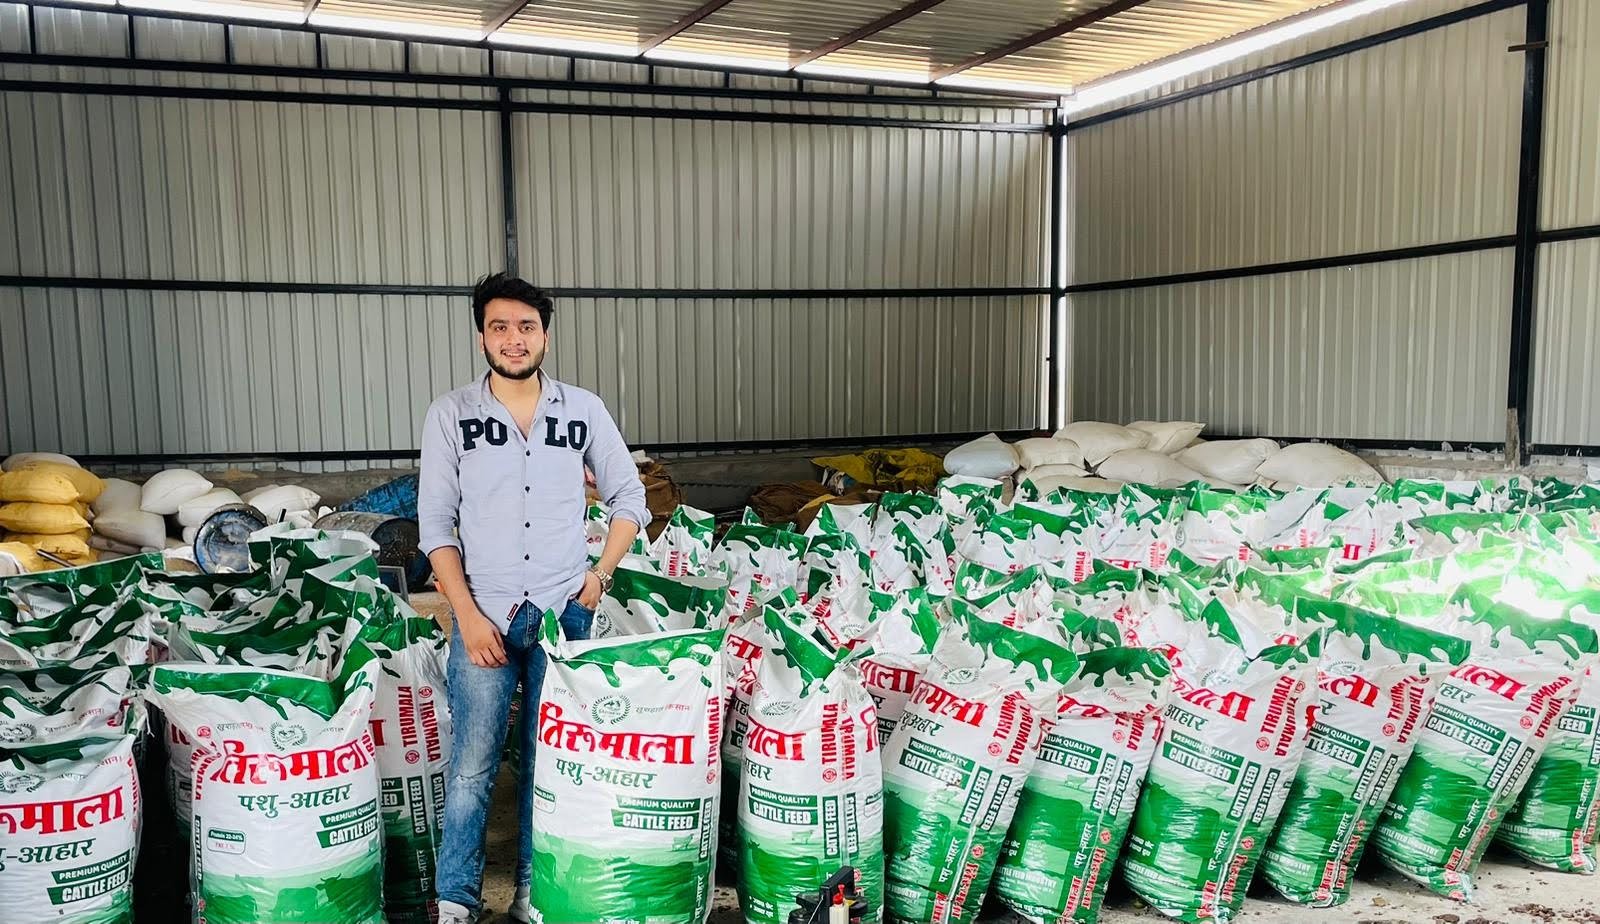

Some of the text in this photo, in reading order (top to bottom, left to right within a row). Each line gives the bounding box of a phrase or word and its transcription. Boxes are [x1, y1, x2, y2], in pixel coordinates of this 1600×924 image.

[1074, 551, 1086, 582] RUMALA
[398, 686, 418, 748] TIRUMALA
[1260, 676, 1296, 734] TIRUMALA
[1397, 685, 1425, 744] TIRUMALA
[1435, 703, 1500, 736] PREMIUM QUALITY
[419, 699, 442, 763] TIRUMALA
[538, 701, 695, 765] तिरूमाला
[706, 696, 720, 766] TIRUMALA
[821, 703, 839, 765] TIRUMALA
[1274, 697, 1299, 757] TIRUMALA
[1332, 727, 1364, 747] QUALITY
[1427, 716, 1494, 754] CATTLE FEED
[1561, 719, 1587, 733] FEED
[935, 747, 968, 766] QUALITY
[1062, 739, 1096, 754] QUALITY
[1064, 754, 1091, 772] FEED
[1169, 745, 1232, 782] CATTLE FEED
[1173, 732, 1237, 763] PREMIUM QUALITY
[1331, 747, 1358, 766] FEED
[556, 758, 658, 789] पशु-आहार
[905, 754, 936, 778] CATTLE
[1114, 764, 1132, 797] CATTLE
[1353, 749, 1384, 801] CATTLE FEED
[1376, 756, 1397, 788] CATTLE
[1486, 740, 1518, 790] CATTLE FEED
[1511, 750, 1533, 781] CATTLE
[238, 783, 353, 819] पशु-आहार
[410, 779, 427, 835] CATTLE FEED
[432, 775, 446, 809] CATTLE
[620, 797, 695, 809] PREMIUM QUALITY
[750, 786, 810, 805] PREMIUM QUALITY
[960, 770, 990, 824] CATTLE FEED
[980, 778, 1009, 831] CATTLE FEED
[1230, 765, 1259, 818] CATTLE FEED
[1251, 771, 1279, 824] CATTLE FEED
[325, 803, 377, 824] PREMIUM QUALITY
[622, 812, 694, 830] CATTLE FEED
[699, 800, 713, 858] CATTLE FEED
[753, 801, 811, 824] CATTLE FEED
[825, 800, 838, 857] CATTLE FEED
[329, 817, 378, 846] CATTLE FEED
[59, 854, 128, 880] PREMIUM QUALITY
[62, 868, 127, 903] CATTLE FEED
